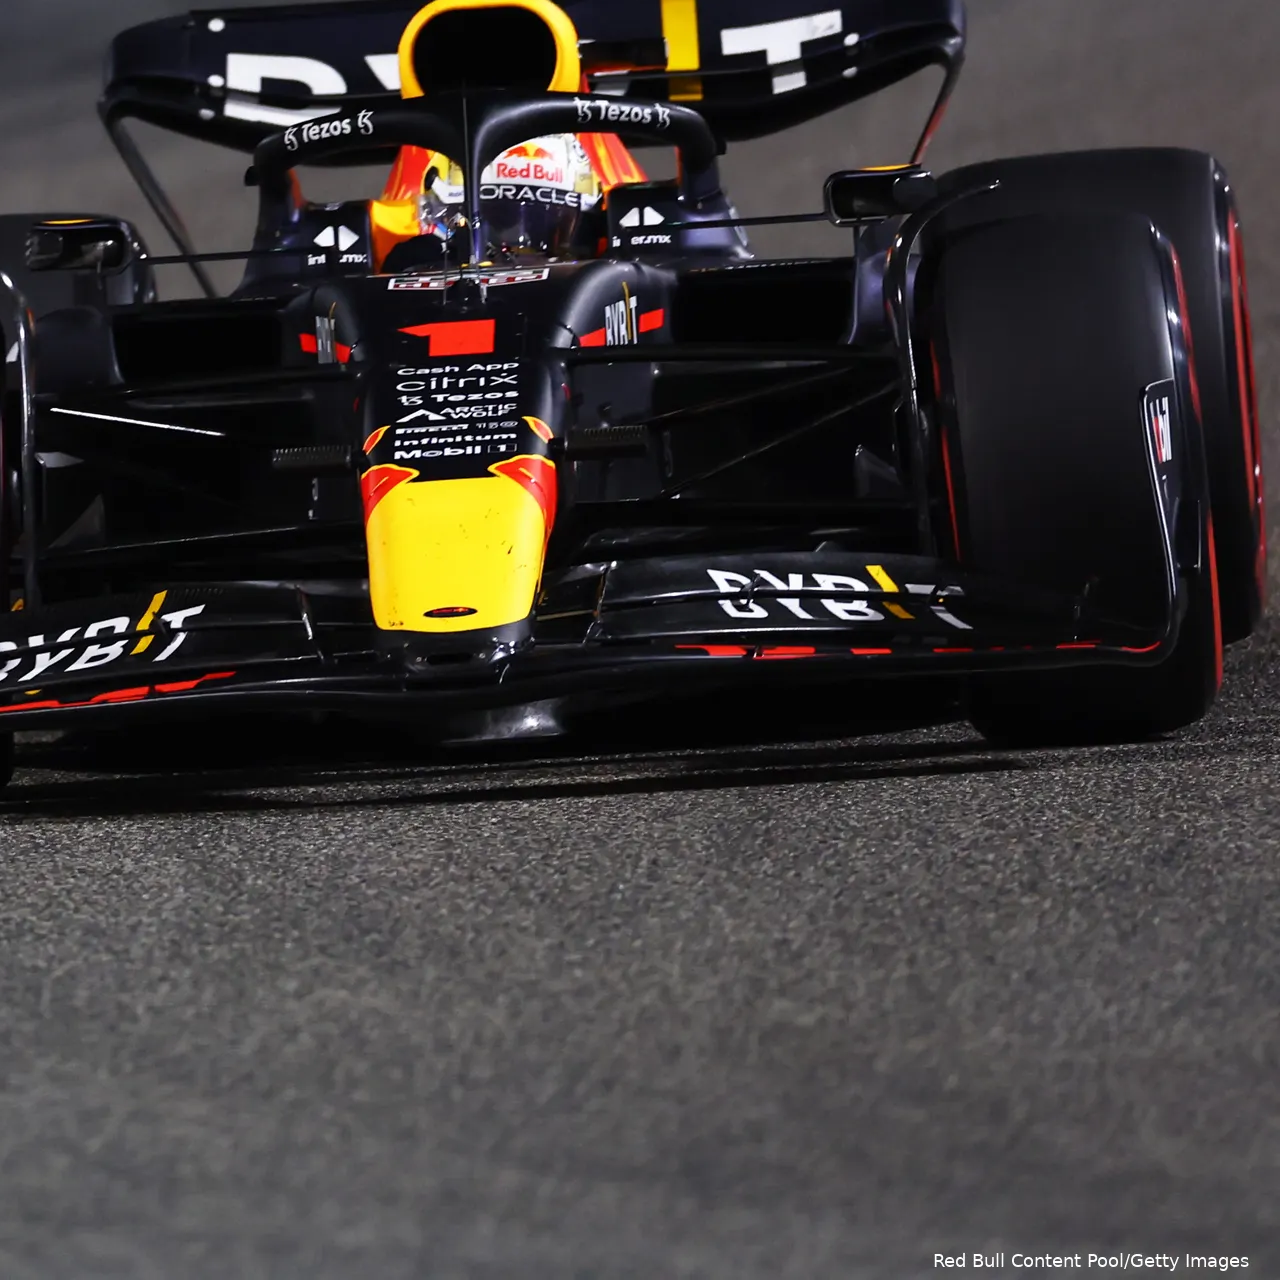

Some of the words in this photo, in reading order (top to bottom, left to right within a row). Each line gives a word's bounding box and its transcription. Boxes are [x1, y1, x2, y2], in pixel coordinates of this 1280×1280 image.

[597, 100, 652, 123] Tezos
[301, 119, 351, 142] Tezos
[496, 163, 531, 179] Red
[534, 164, 563, 183] Bull
[480, 185, 579, 208] ORACLE
[397, 318, 495, 357] 1
[396, 365, 459, 375] Cash
[466, 361, 519, 372] App
[430, 390, 519, 403] Tezos
[439, 403, 517, 414] ARCTIC
[449, 408, 508, 418] WOLF
[393, 444, 481, 460] Mobil
